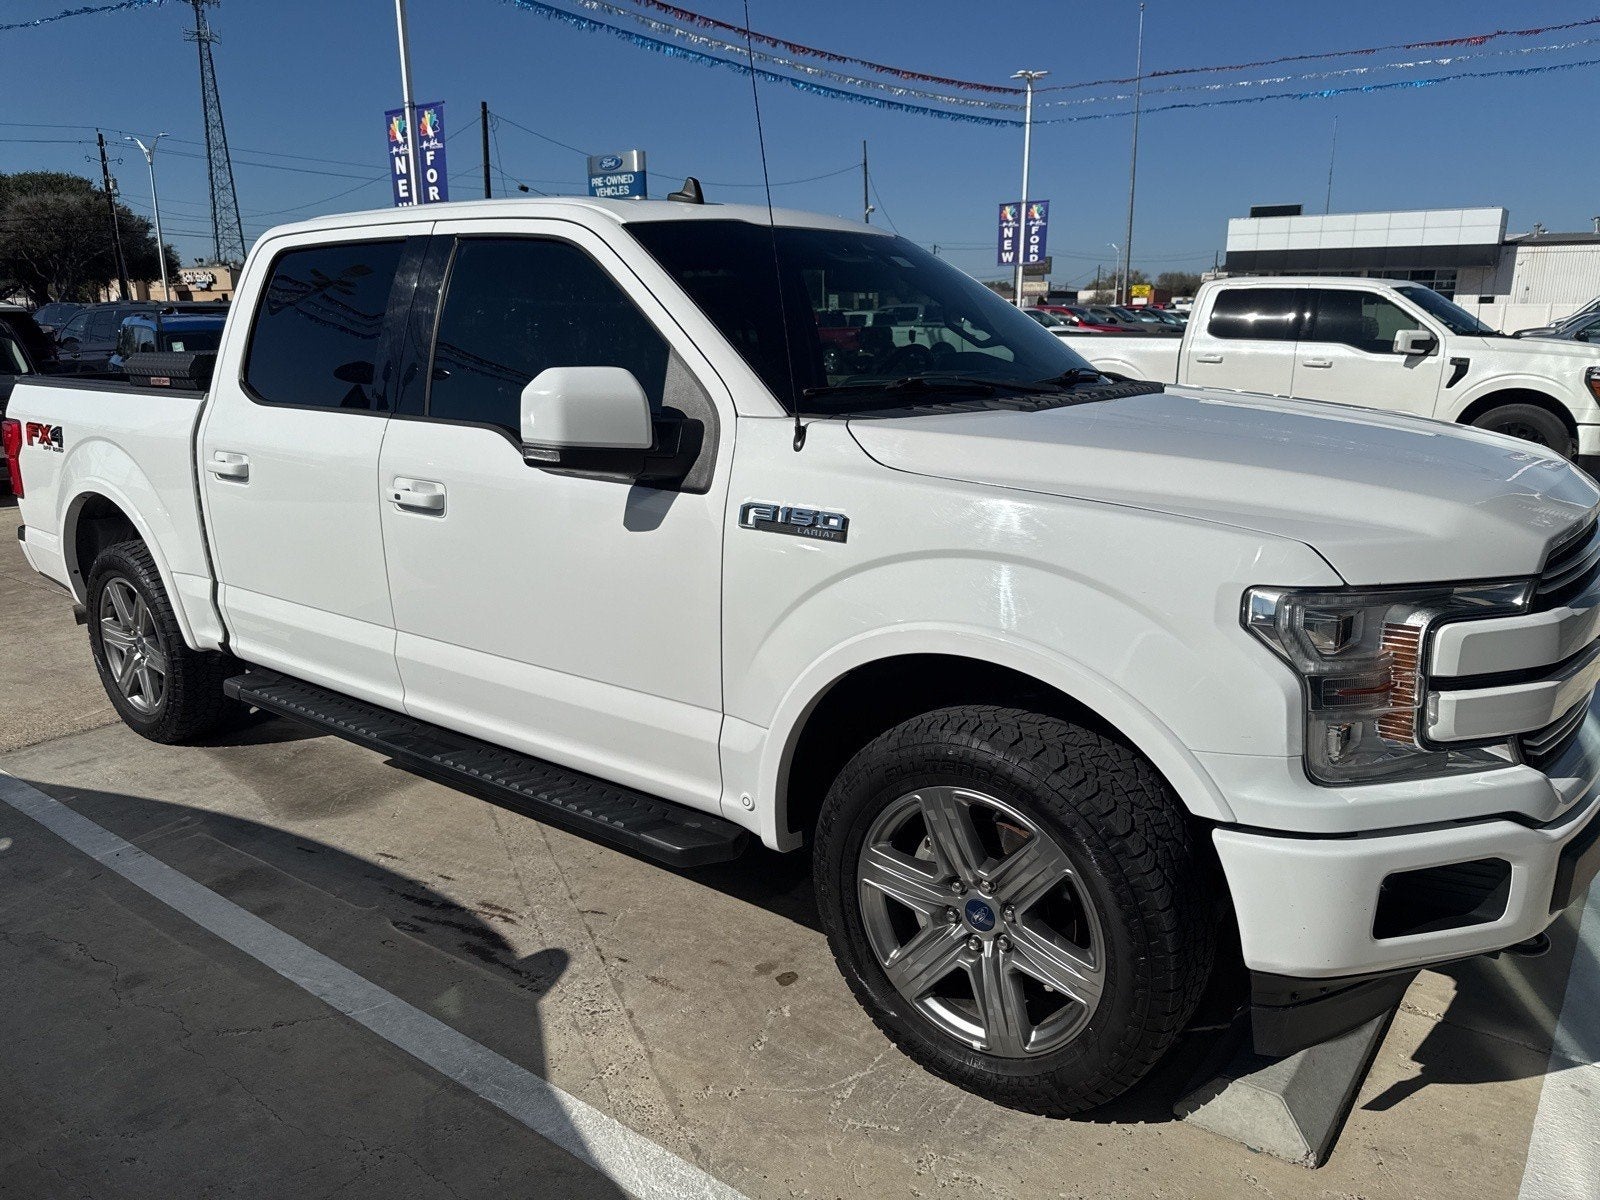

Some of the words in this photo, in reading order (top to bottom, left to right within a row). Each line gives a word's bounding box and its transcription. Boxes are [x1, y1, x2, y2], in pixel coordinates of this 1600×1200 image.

[601, 159, 616, 168] Ford
[591, 174, 635, 187] PRE-OWNED
[595, 185, 630, 197] VEHICLES
[1001, 227, 1014, 263] NEW
[1029, 226, 1040, 262] FORD
[26, 421, 64, 448] FX4
[797, 528, 837, 539] LARIAT
